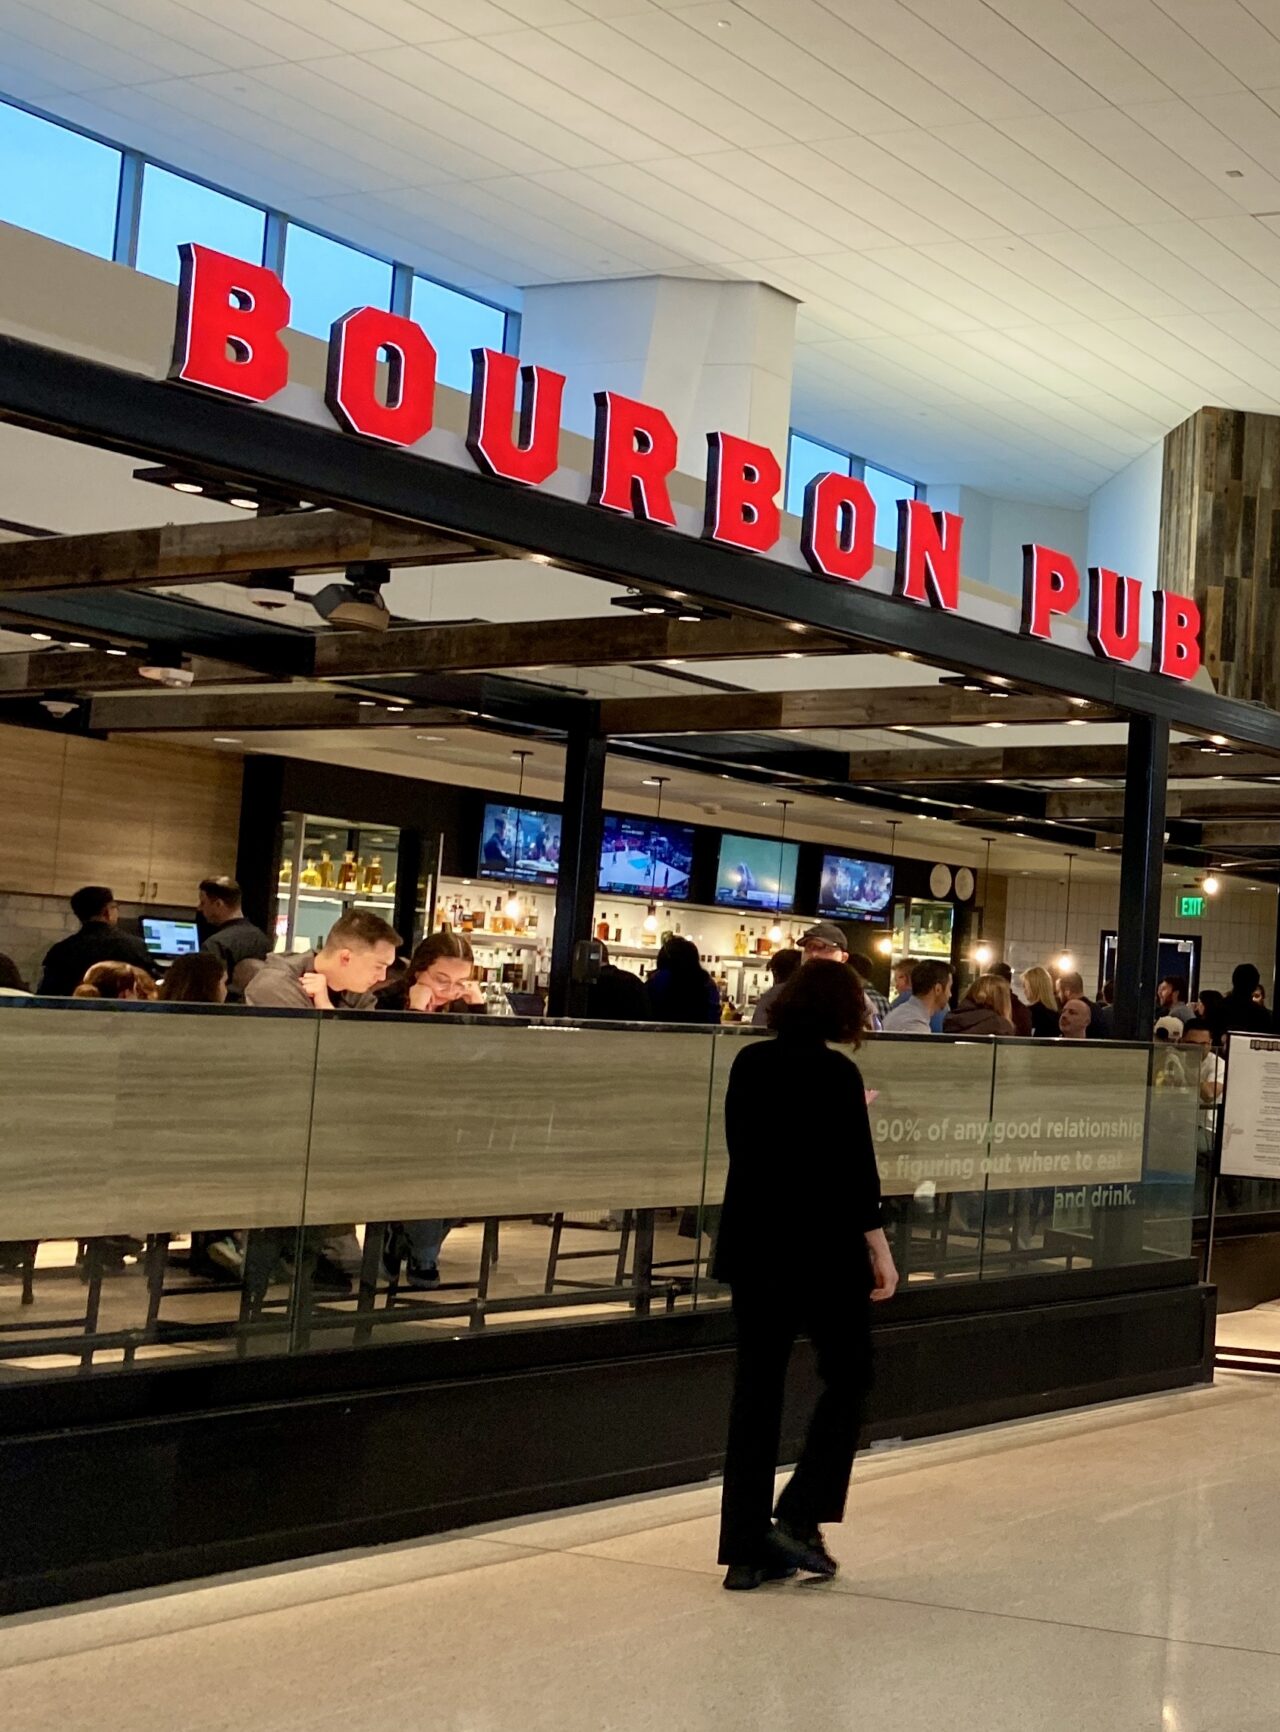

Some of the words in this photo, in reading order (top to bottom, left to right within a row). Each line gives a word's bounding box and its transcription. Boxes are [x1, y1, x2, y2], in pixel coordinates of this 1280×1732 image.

[168, 241, 964, 611] BOURBON
[1019, 543, 1206, 682] PUB
[1181, 896, 1204, 916] EXIT
[876, 1118, 921, 1142] 90%
[928, 1118, 950, 1141] of
[954, 1121, 988, 1145] any
[994, 1117, 1041, 1143] good
[1047, 1116, 1144, 1142] relationship
[896, 1153, 974, 1183] figuring
[980, 1154, 1012, 1175] out
[1017, 1150, 1071, 1173] where
[1076, 1150, 1093, 1171] to
[1097, 1150, 1124, 1172] eat
[1055, 1186, 1087, 1209] and
[1091, 1184, 1136, 1208] drink.
